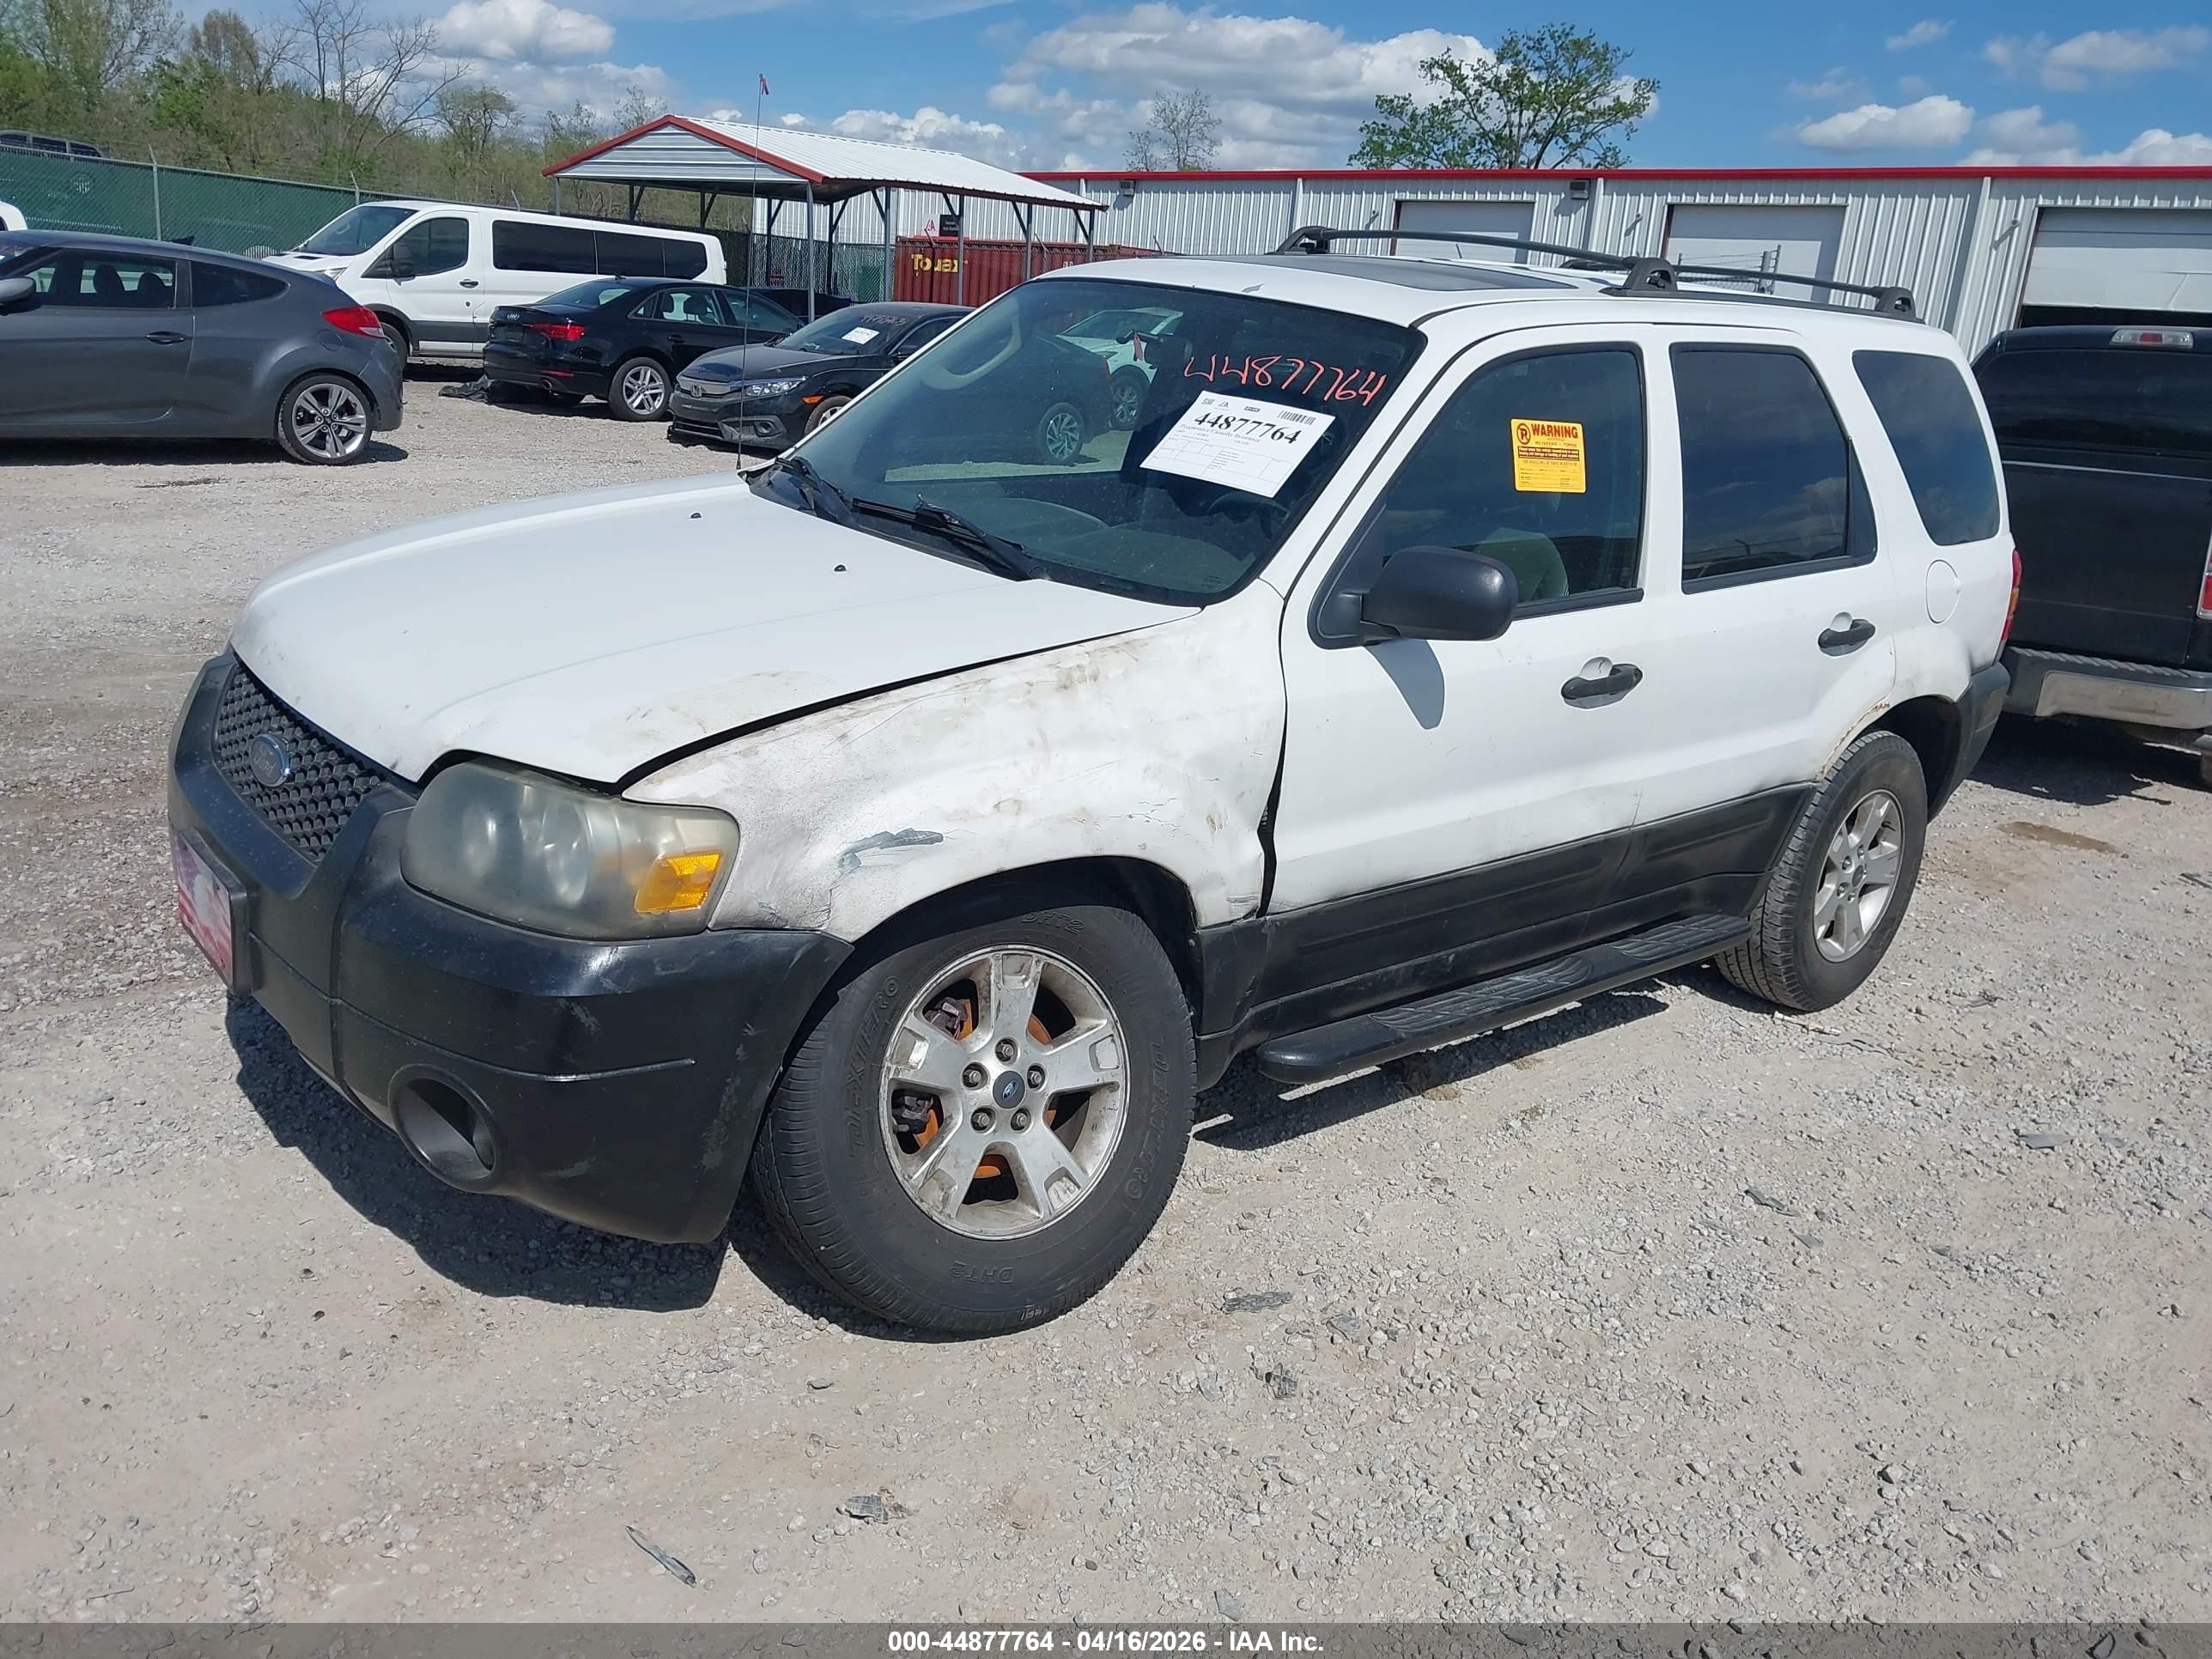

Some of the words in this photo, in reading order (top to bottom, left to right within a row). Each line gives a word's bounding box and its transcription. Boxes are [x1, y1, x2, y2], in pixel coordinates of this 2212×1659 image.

[1183, 354, 1388, 406] 44877764
[1194, 412, 1302, 444] 44877764
[1531, 423, 1578, 439] WARNING
[949, 1260, 1015, 1285] DHT2
